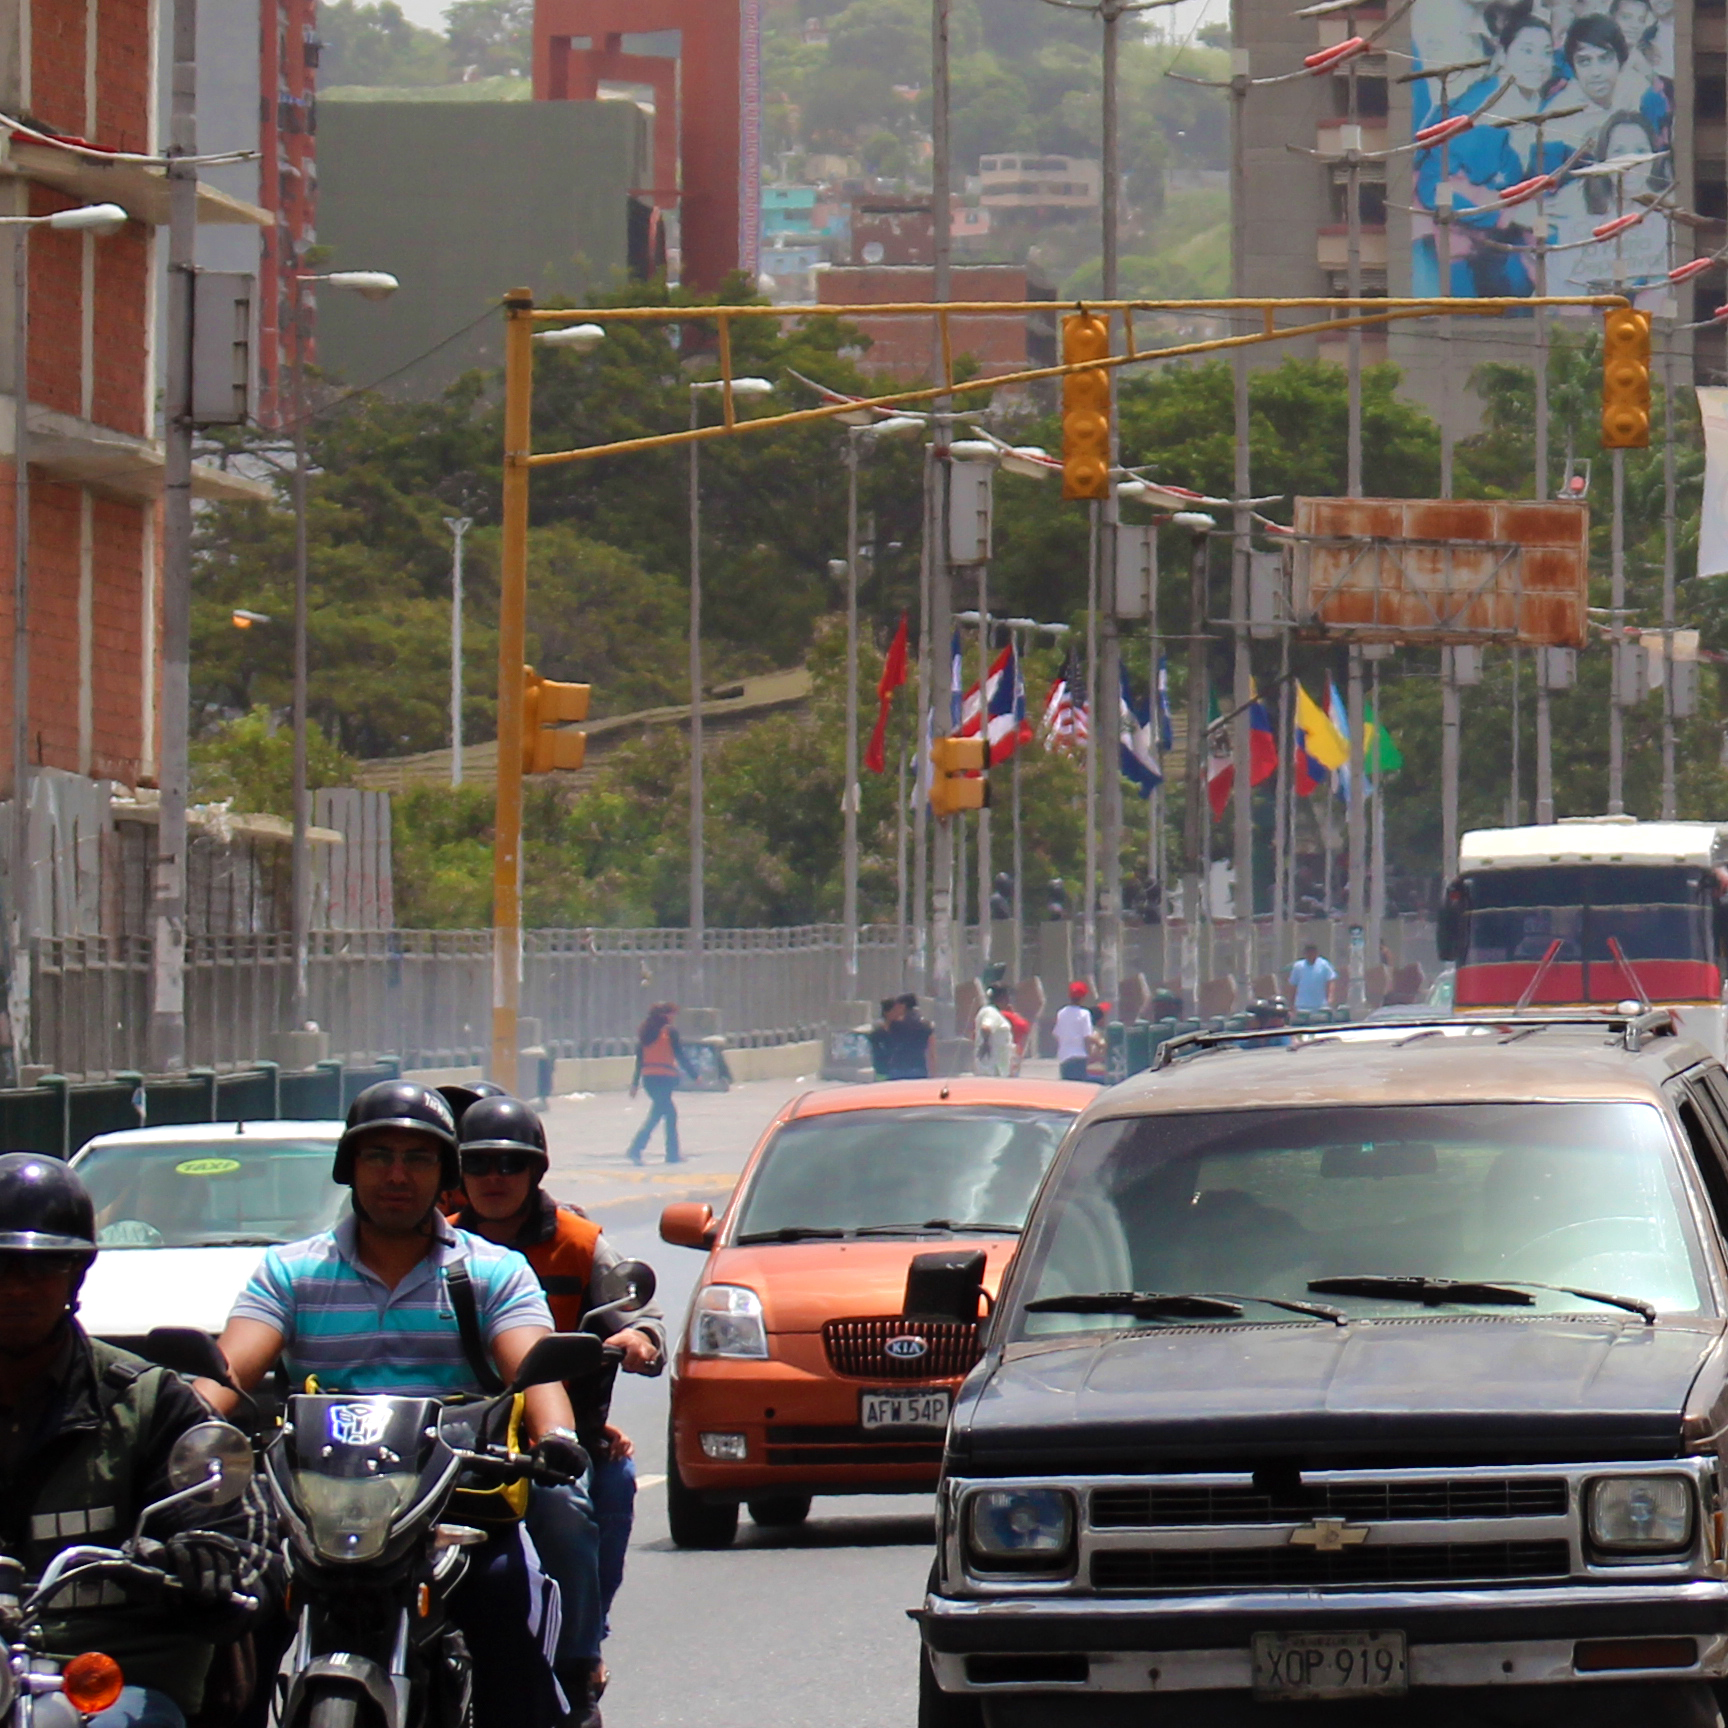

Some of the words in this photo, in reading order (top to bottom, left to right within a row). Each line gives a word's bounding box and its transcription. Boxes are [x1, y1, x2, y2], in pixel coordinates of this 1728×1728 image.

[892, 1342, 920, 1354] KIA
[867, 1400, 901, 1423] AFW
[908, 1399, 944, 1422] 54P
